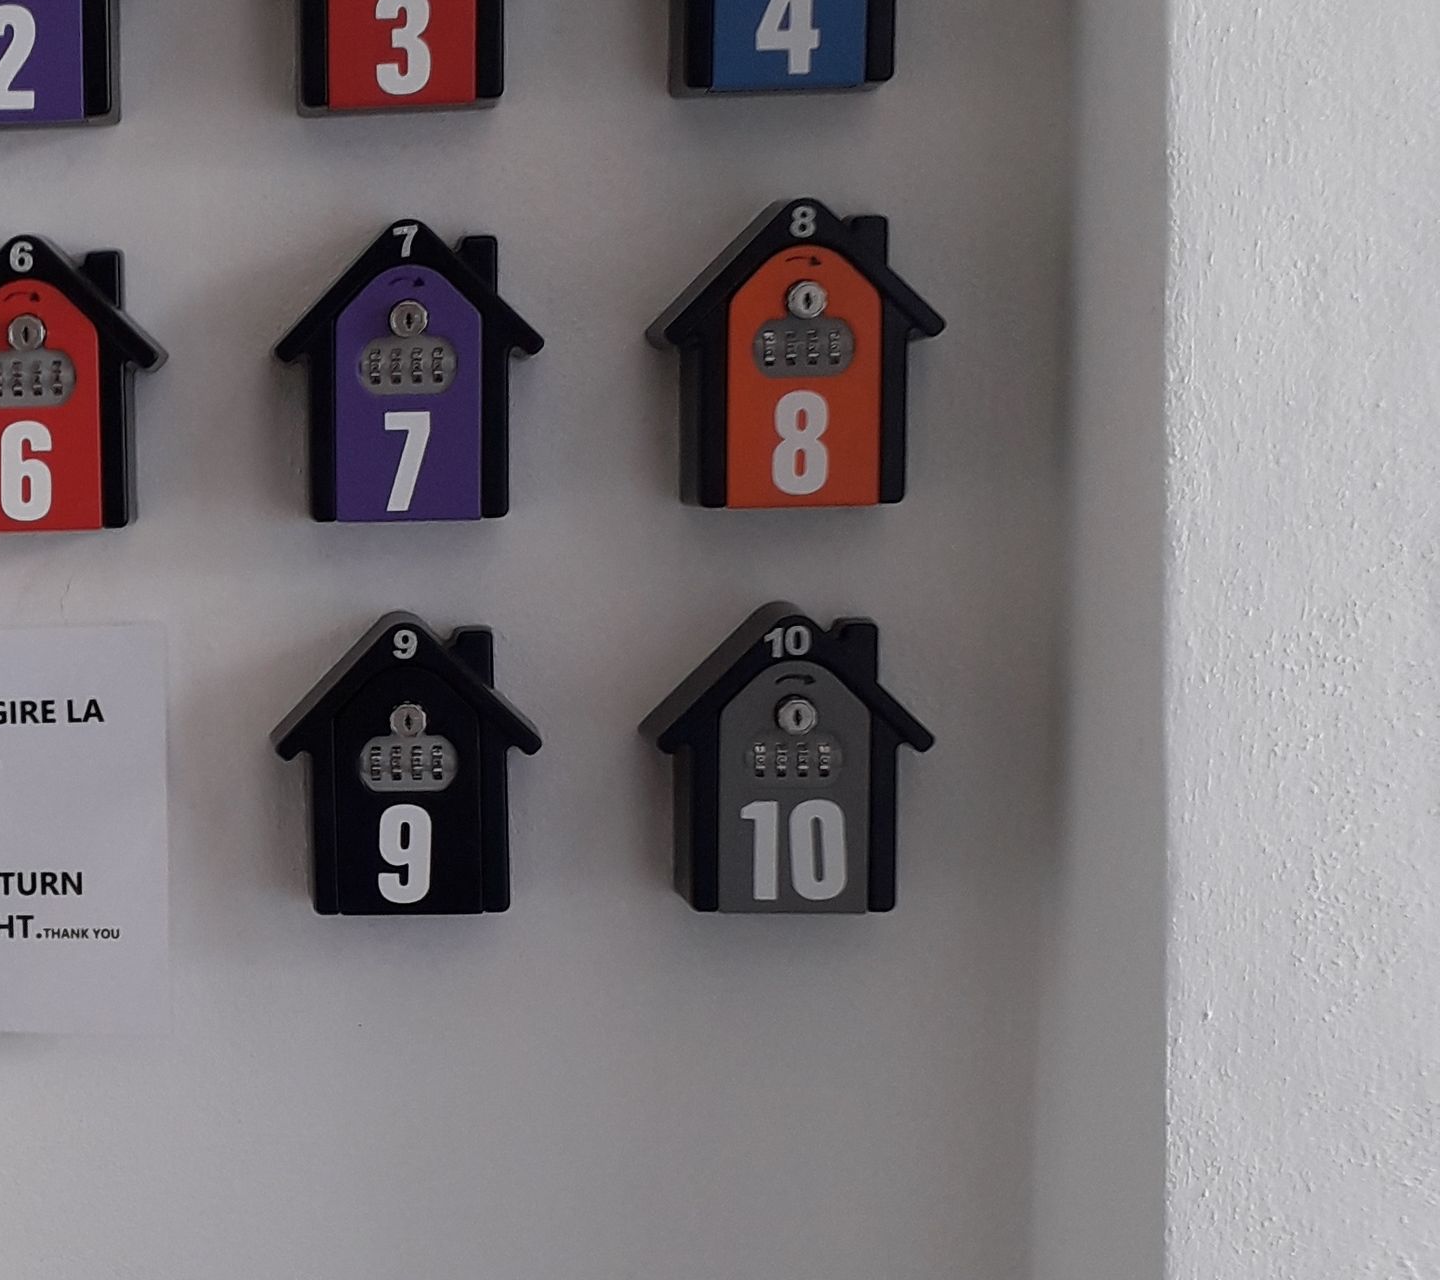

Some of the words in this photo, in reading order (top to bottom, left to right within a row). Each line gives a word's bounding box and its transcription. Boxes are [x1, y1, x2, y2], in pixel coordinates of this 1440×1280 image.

[790, 205, 817, 238] 8
[8, 241, 34, 273] 6
[391, 225, 419, 258] 7
[771, 389, 829, 495] 8
[0, 420, 53, 522] 6
[384, 410, 431, 512] 7
[392, 629, 418, 660] 9
[763, 625, 811, 658] 10
[66, 698, 105, 724] LA
[377, 803, 432, 904] 9
[740, 799, 847, 901] 10
[42, 927, 89, 939] THANK
[92, 928, 120, 940] YOU
